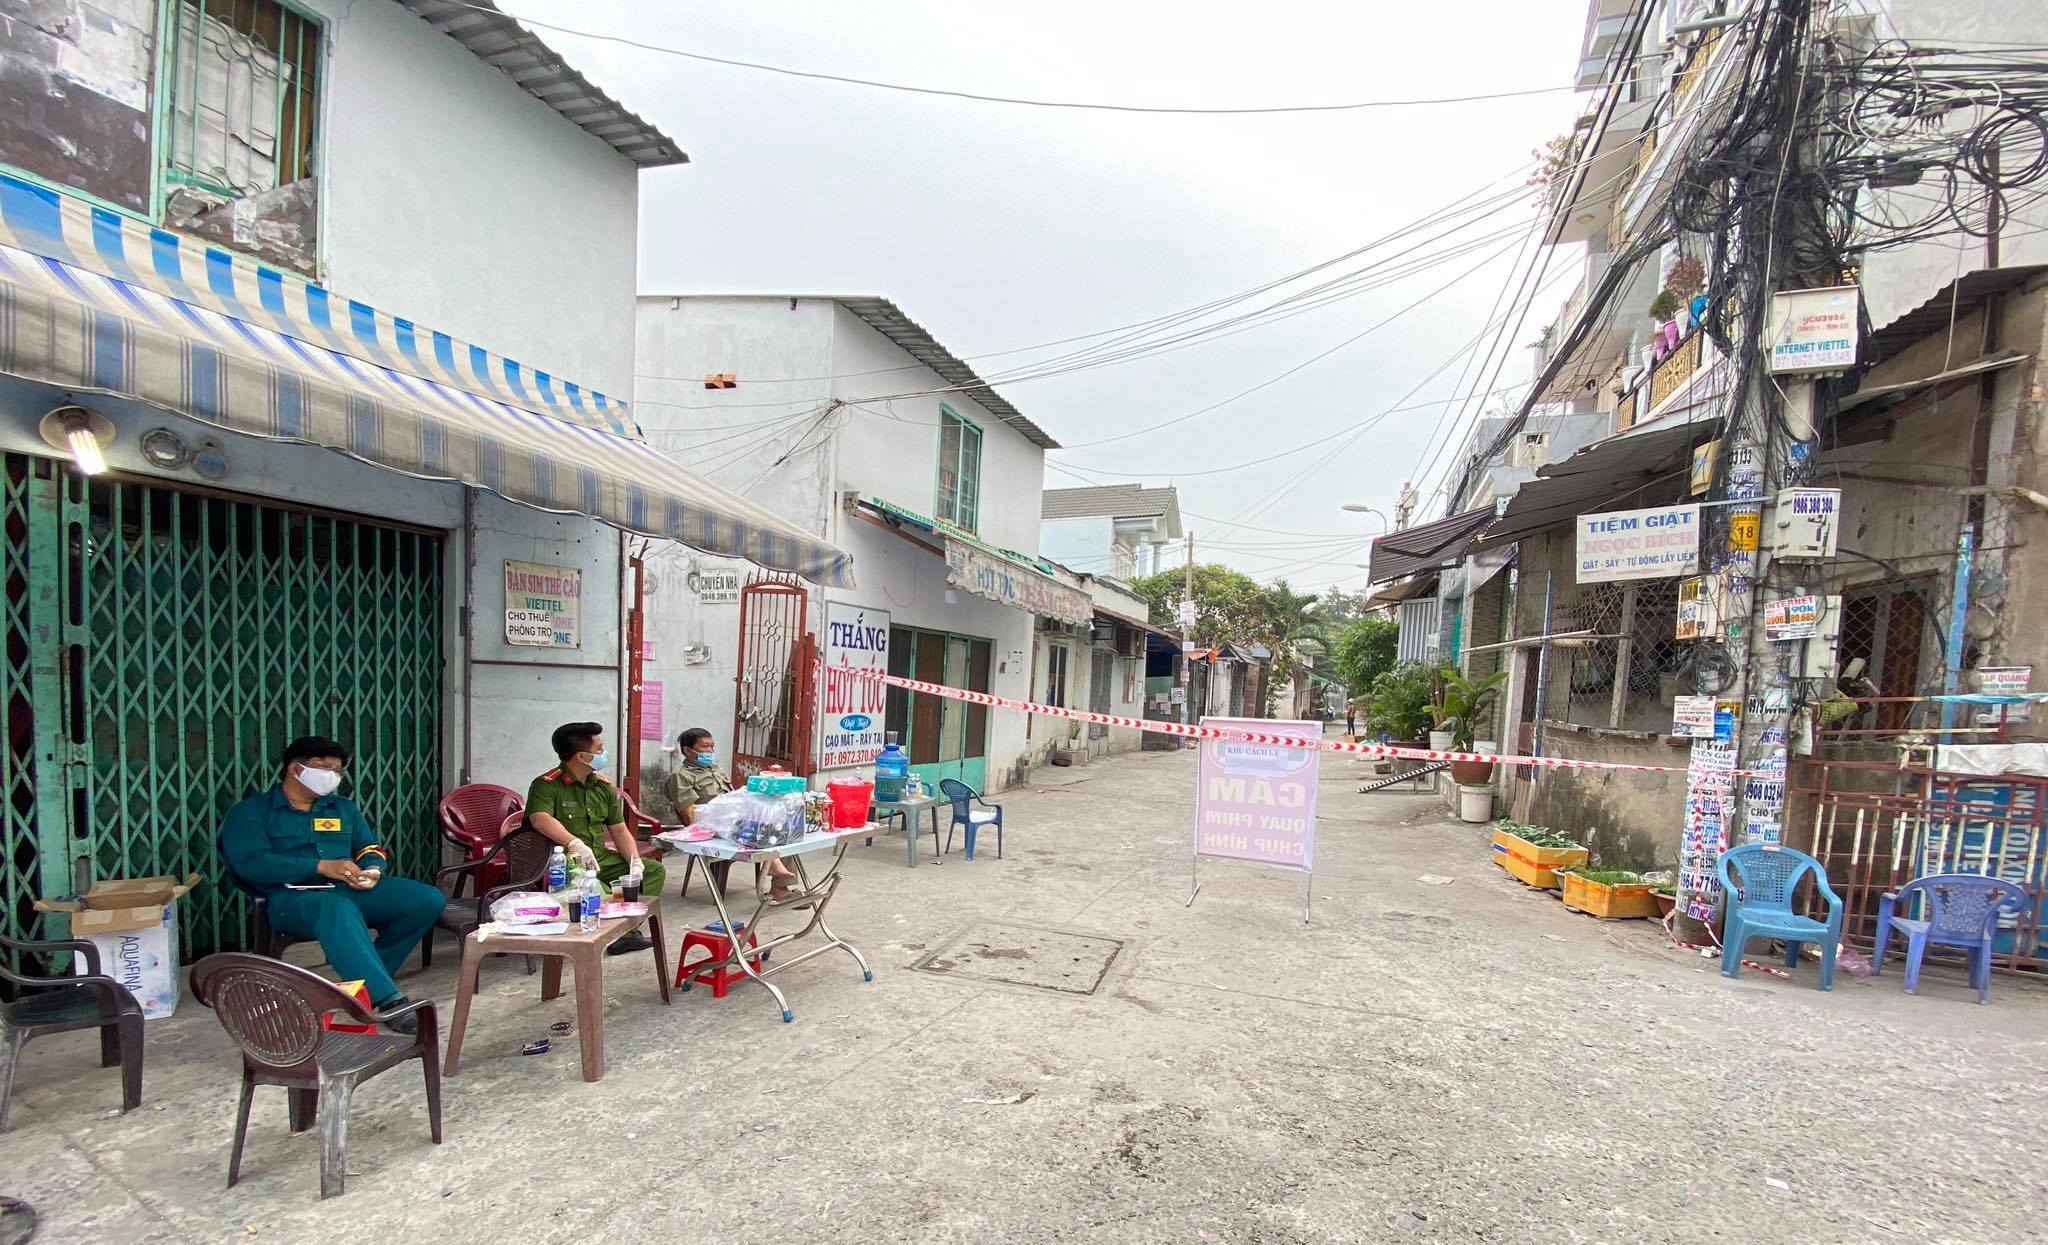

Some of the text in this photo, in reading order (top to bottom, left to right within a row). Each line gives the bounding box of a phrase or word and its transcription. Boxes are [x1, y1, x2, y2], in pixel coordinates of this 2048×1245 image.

[1775, 339, 1850, 355] INTERNET VIETTEL
[1587, 511, 1692, 534] TIỆM GIẶT
[1583, 529, 1695, 555] NGỌC BÍCH
[1638, 554, 1659, 566] ĐỘNG
[506, 567, 528, 593] BÁN
[528, 574, 543, 594] SIM
[544, 569, 562, 596] THẺ
[526, 597, 565, 612] VIETTEL
[1765, 596, 1814, 610] INTERNET
[508, 611, 550, 622] CHO THUÊ
[509, 623, 536, 636] PHÒNG
[829, 612, 887, 652] THẮNG
[825, 651, 886, 714] HỚT TÓC
[825, 734, 840, 751] CẠO
[840, 731, 855, 750] MẶT
[873, 731, 883, 745] TAI
[824, 751, 837, 767] ĐT:
[1227, 747, 1244, 755] KHU
[118, 935, 143, 992] AQUAFINA
